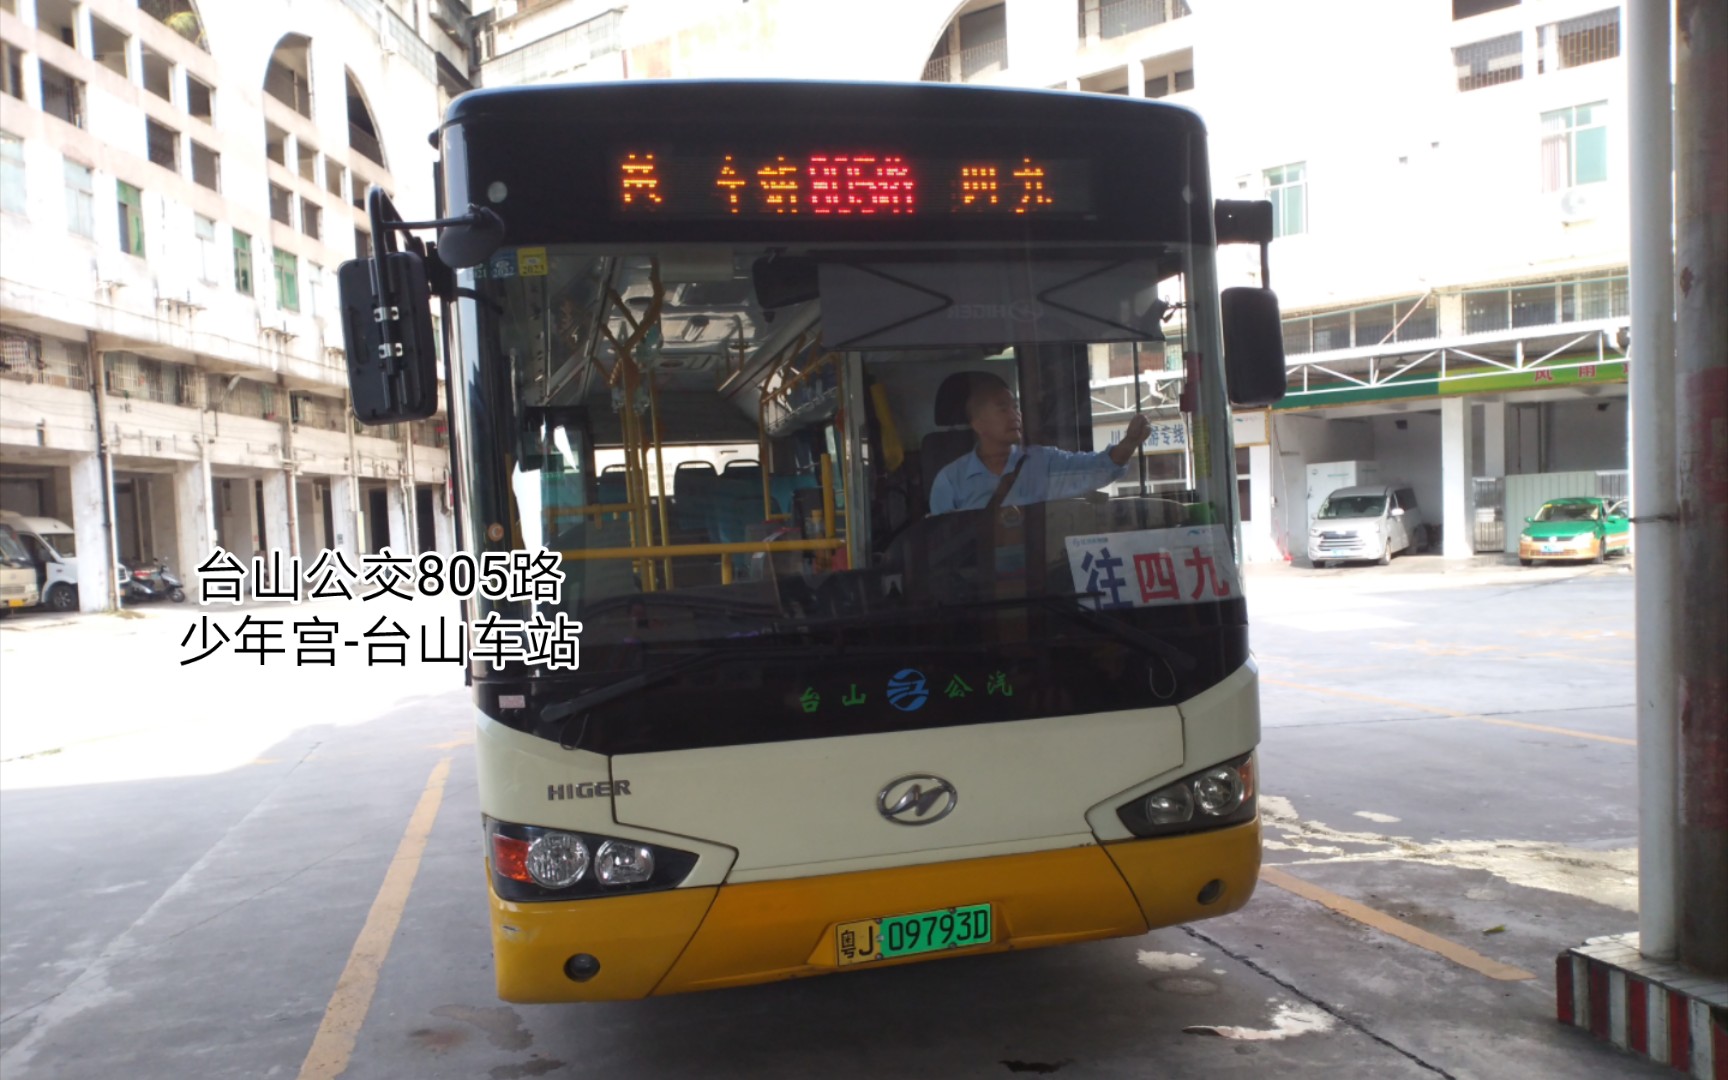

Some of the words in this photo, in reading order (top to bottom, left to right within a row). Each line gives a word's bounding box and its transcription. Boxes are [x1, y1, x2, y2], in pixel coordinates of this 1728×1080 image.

[1081, 547, 1231, 611] 往四九
[547, 779, 631, 801] HIGER
